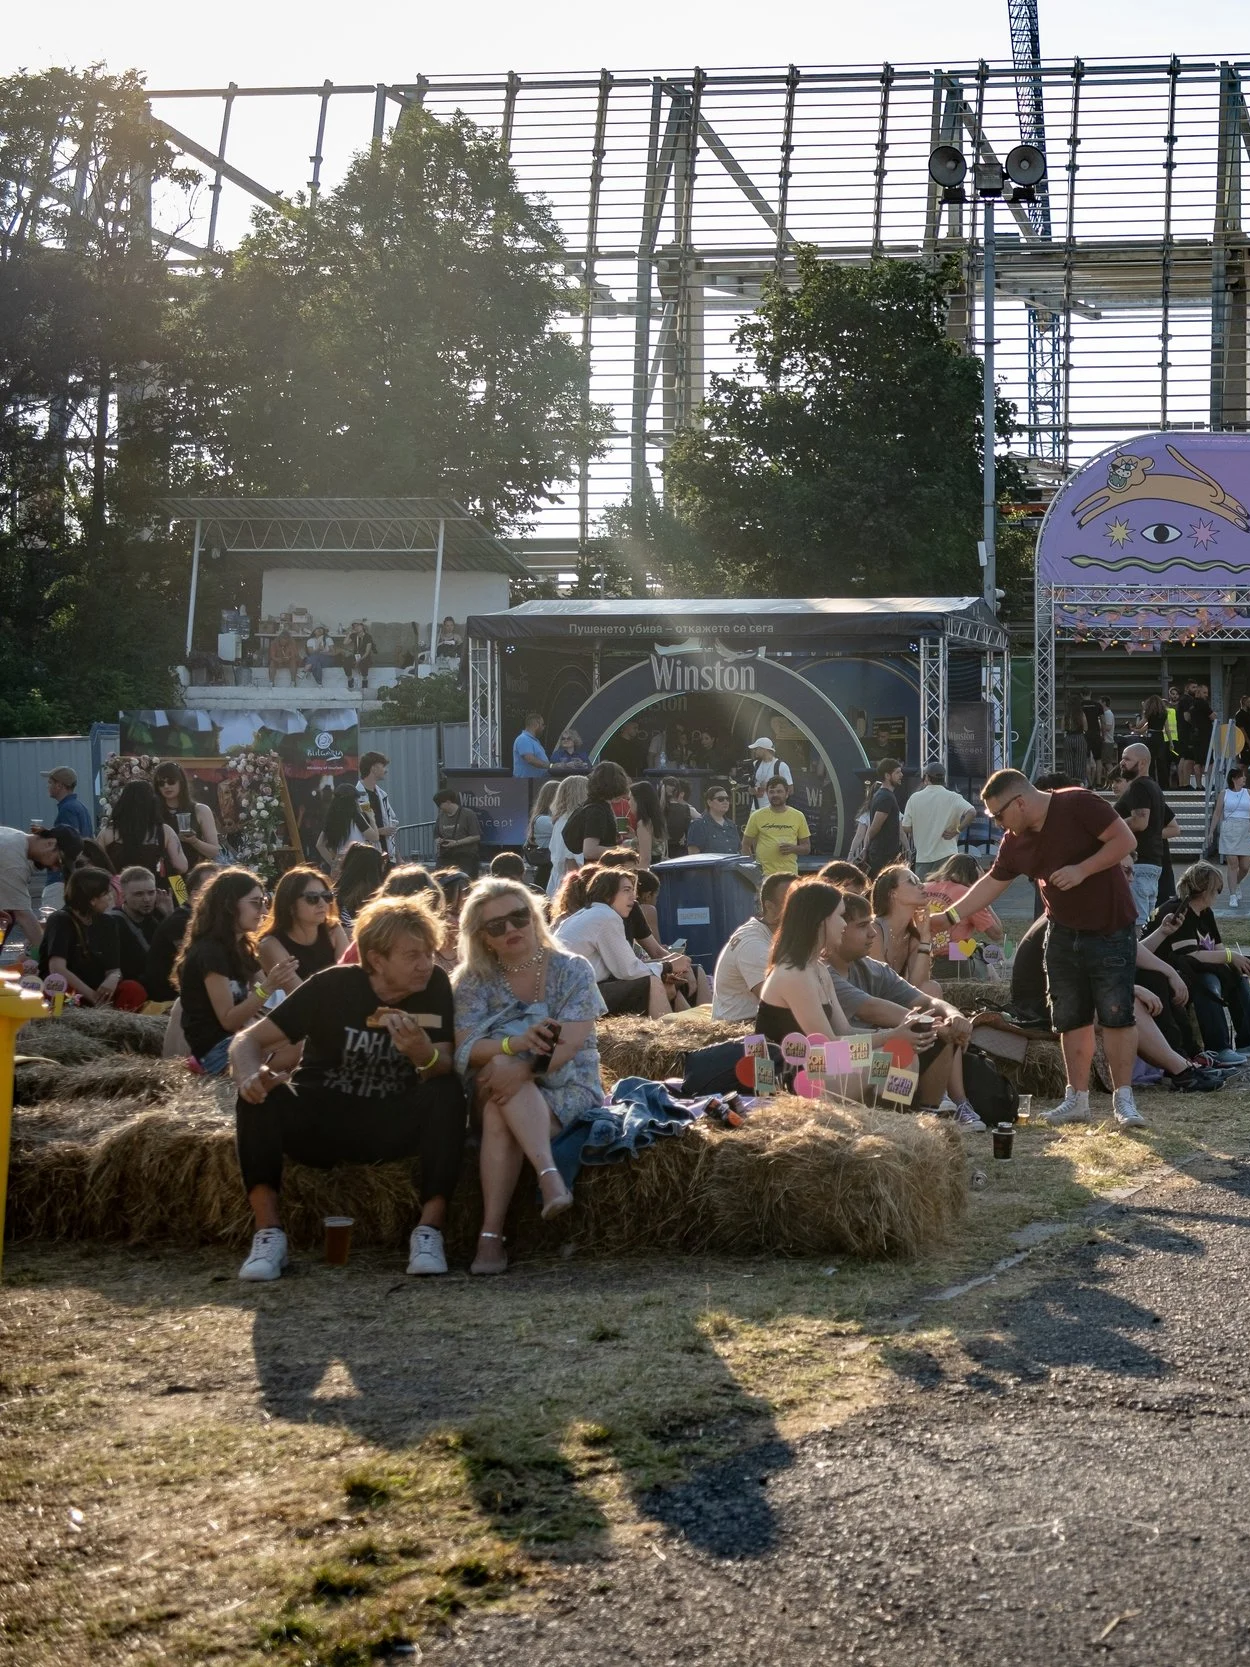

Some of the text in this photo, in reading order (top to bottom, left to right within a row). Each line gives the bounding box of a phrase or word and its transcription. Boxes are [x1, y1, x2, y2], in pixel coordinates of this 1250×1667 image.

[569, 623, 626, 636] Пушенето
[629, 622, 663, 636] убива
[675, 624, 730, 634] откажете
[733, 624, 747, 634] се
[749, 624, 774, 634] сега
[650, 653, 756, 691] Winston
[459, 791, 501, 807] Winston
[480, 818, 513, 828] ncept
[849, 1041, 868, 1053] OFIA
[808, 1054, 826, 1065] SOFI
